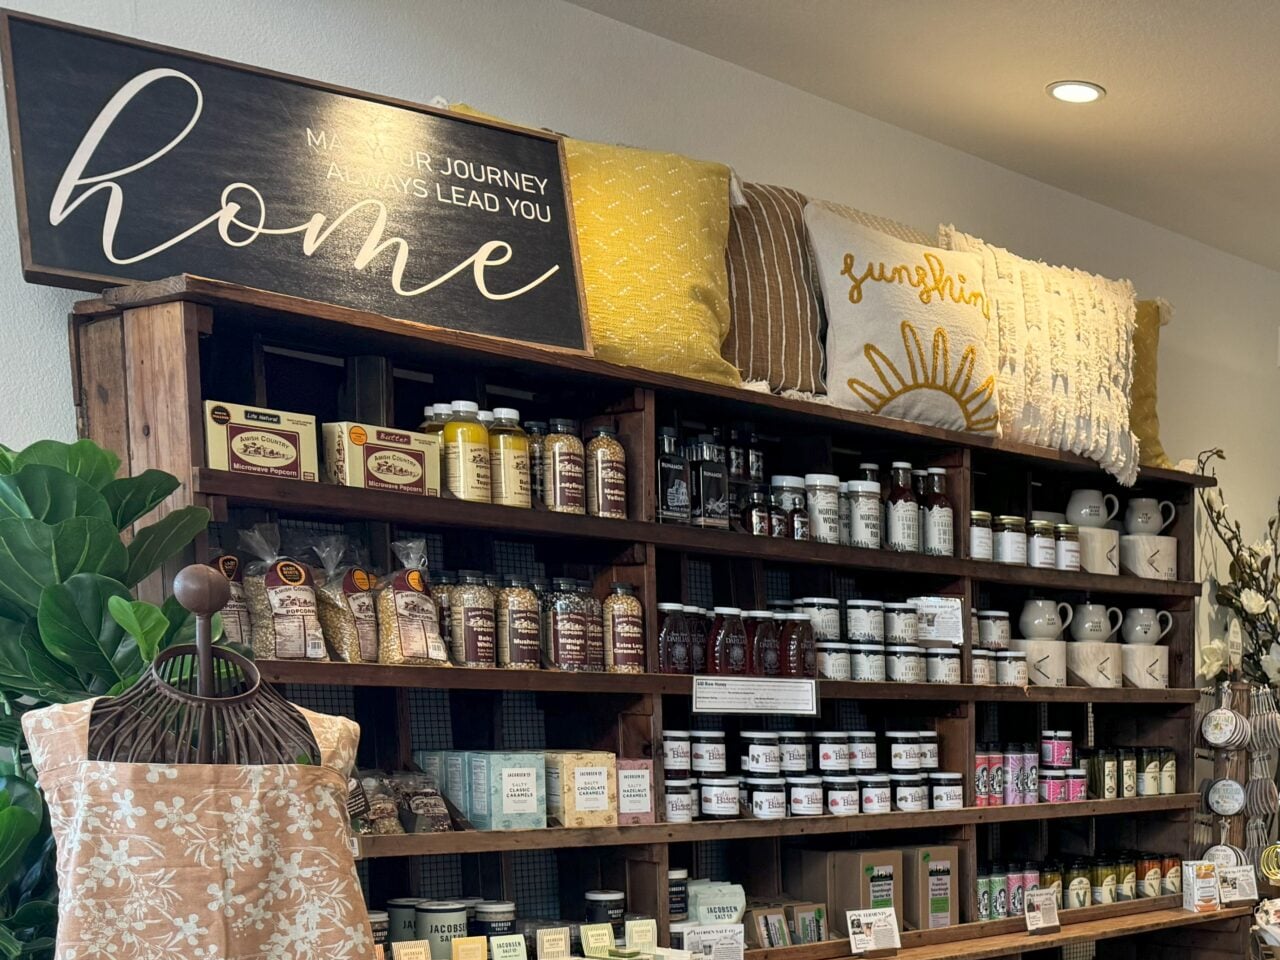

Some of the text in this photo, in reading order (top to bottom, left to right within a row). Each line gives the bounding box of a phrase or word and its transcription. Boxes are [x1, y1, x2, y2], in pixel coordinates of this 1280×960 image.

[440, 157, 548, 195] JOURNEY
[50, 68, 559, 301] home
[326, 161, 551, 223] ALWAYS LEAD YOU
[379, 432, 409, 443] Butter
[233, 462, 298, 478] Microwave Popcorn
[368, 480, 423, 494] Microwave Popcorn
[478, 634, 493, 643] Baby
[706, 905, 738, 914] JACOBSEN
[496, 941, 522, 950] JACOBSEN
